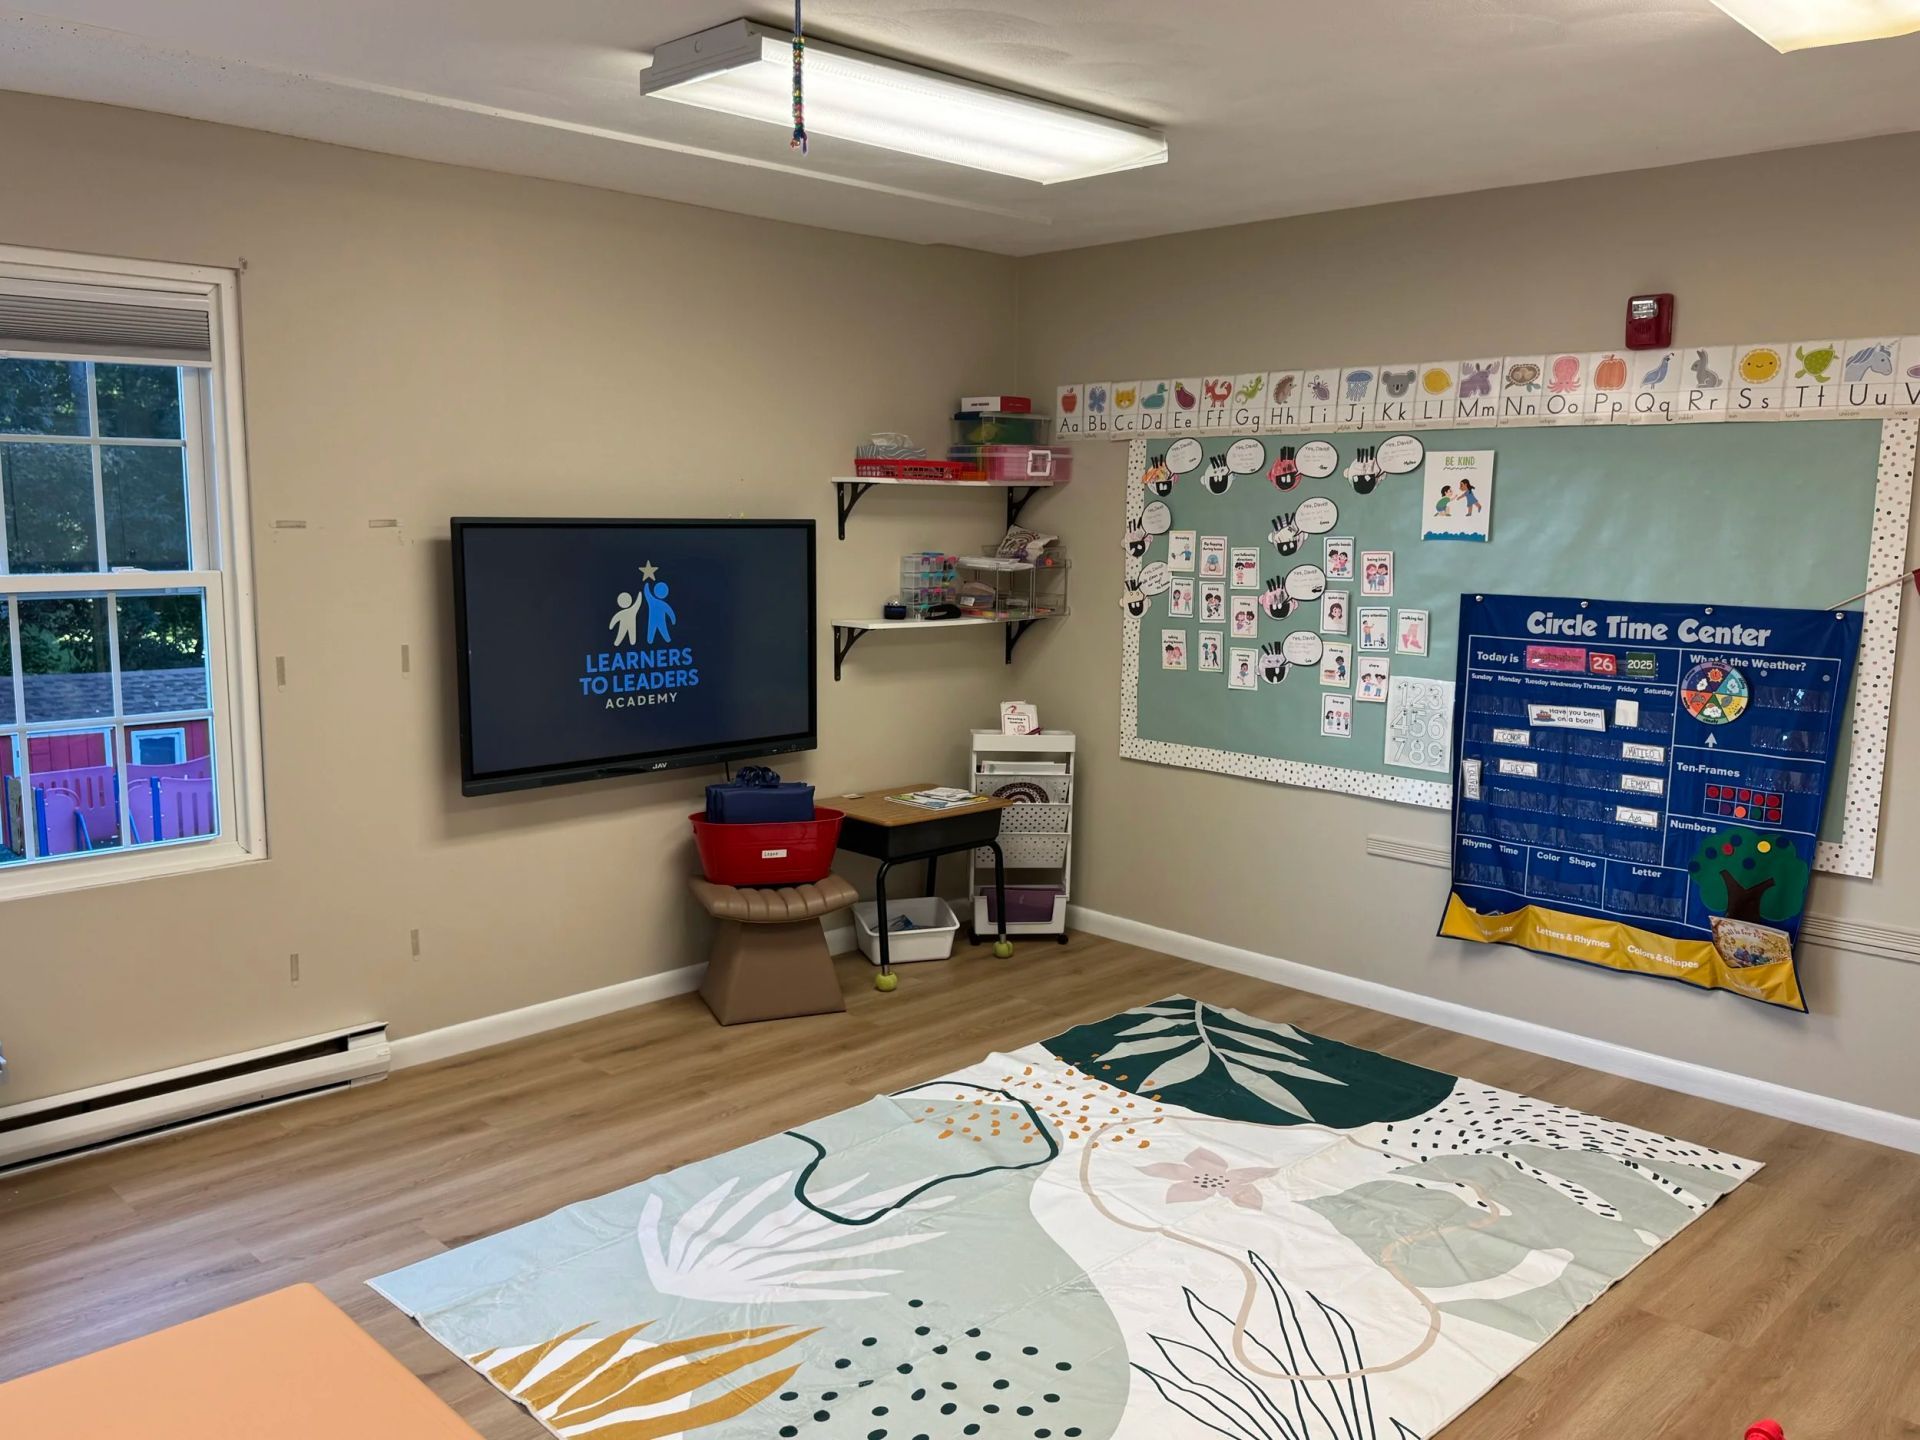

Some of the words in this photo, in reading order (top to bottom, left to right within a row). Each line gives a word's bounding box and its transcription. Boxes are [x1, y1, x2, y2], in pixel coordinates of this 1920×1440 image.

[1060, 417, 1079, 433] Aa
[1088, 415, 1107, 431] Bb
[1114, 414, 1134, 431] Cc
[1142, 413, 1162, 430] Dd
[1174, 411, 1191, 429] Ee
[1206, 409, 1225, 427] Ff
[1236, 408, 1260, 433] Gg
[1271, 407, 1294, 425] Hh
[1382, 401, 1406, 421] Kk
[1458, 398, 1496, 418] Mm
[1505, 396, 1536, 416] Nn
[1547, 394, 1579, 414] Oo
[1594, 393, 1623, 422] Pp
[1635, 392, 1673, 422] Qq
[1849, 383, 1888, 406] Uu
[1445, 456, 1454, 466] BE
[1457, 456, 1475, 467] KIND
[1526, 611, 1598, 638] Circle
[1606, 615, 1669, 641] Time
[1677, 618, 1772, 648] Center
[586, 647, 694, 674] LEARNERS
[1476, 650, 1508, 665] Today
[1509, 652, 1519, 664] is
[1592, 656, 1614, 672] 26
[1627, 659, 1654, 671] 2025
[1728, 656, 1750, 668] the
[1750, 658, 1807, 672] Weather?
[579, 676, 608, 696] TO
[612, 668, 700, 693] LEADERS
[1471, 672, 1493, 682] Sunday
[1497, 675, 1522, 685] Monday
[1524, 677, 1549, 688] Tuesday
[1549, 680, 1583, 690] Wednesday
[1583, 682, 1613, 693] Thursday
[1617, 684, 1638, 695] Friday
[1643, 686, 1674, 698] Saturday
[605, 692, 678, 709] ACADEMY
[1411, 682, 1427, 709] 2
[1428, 684, 1444, 711] 3
[1389, 709, 1409, 736] 4
[1408, 710, 1428, 738] 5
[1427, 713, 1445, 740] 6
[1575, 716, 1595, 724] boat?
[1392, 737, 1409, 763] 7
[1408, 739, 1426, 766] 8
[1427, 741, 1443, 767] 9
[1676, 761, 1741, 779] Ten-Frames
[1669, 818, 1718, 834] Numbers
[1462, 838, 1493, 851] Rhyme
[1498, 844, 1519, 856] Time
[1536, 851, 1561, 863] Color
[1568, 855, 1598, 869] Shape
[1632, 866, 1662, 879] Letter
[1535, 925, 1565, 942] Letters
[1566, 933, 1572, 942] &
[1573, 934, 1611, 949] Rhymes
[1626, 944, 1656, 962] Colors
[1656, 953, 1664, 962] &
[1663, 954, 1700, 969] Shapes
